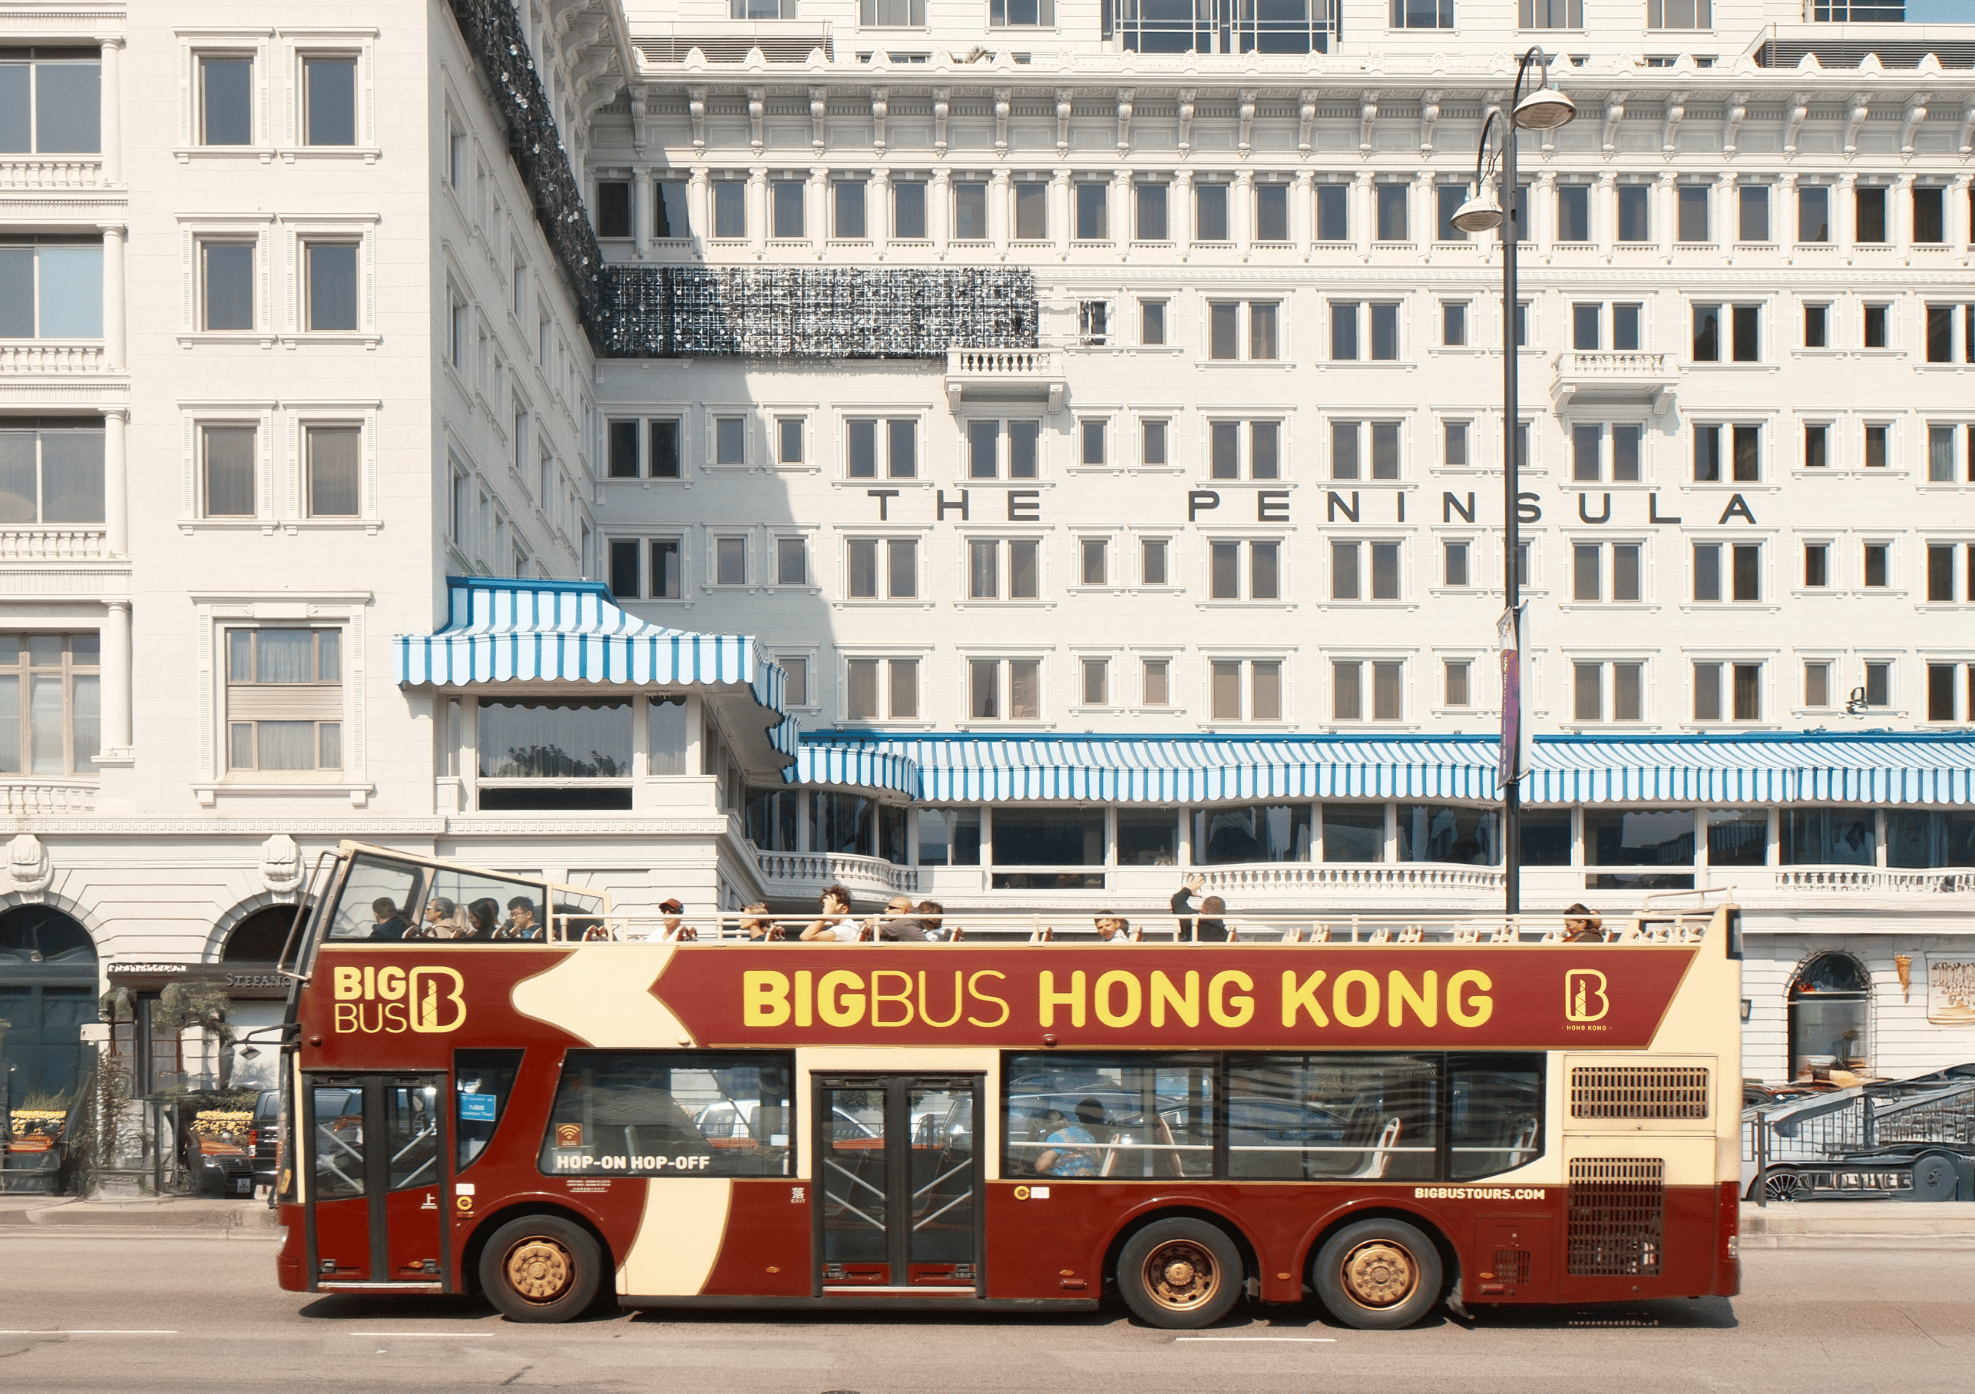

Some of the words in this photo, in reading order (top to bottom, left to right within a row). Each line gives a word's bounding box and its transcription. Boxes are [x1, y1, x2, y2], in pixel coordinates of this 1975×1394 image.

[867, 490, 1040, 521] THE
[1188, 490, 1757, 525] PENINSULA
[333, 965, 406, 1000] BIG
[1039, 969, 1255, 1028] HONG
[1281, 969, 1493, 1028] KONG
[334, 1002, 407, 1034] BUS
[556, 1155, 627, 1170] HOP-ON
[630, 1155, 711, 1170] HOP-OFF
[422, 1193, 436, 1205] 上
[791, 1187, 805, 1198] 落
[1414, 1188, 1545, 1200] BIGBUSTOURS.COM
